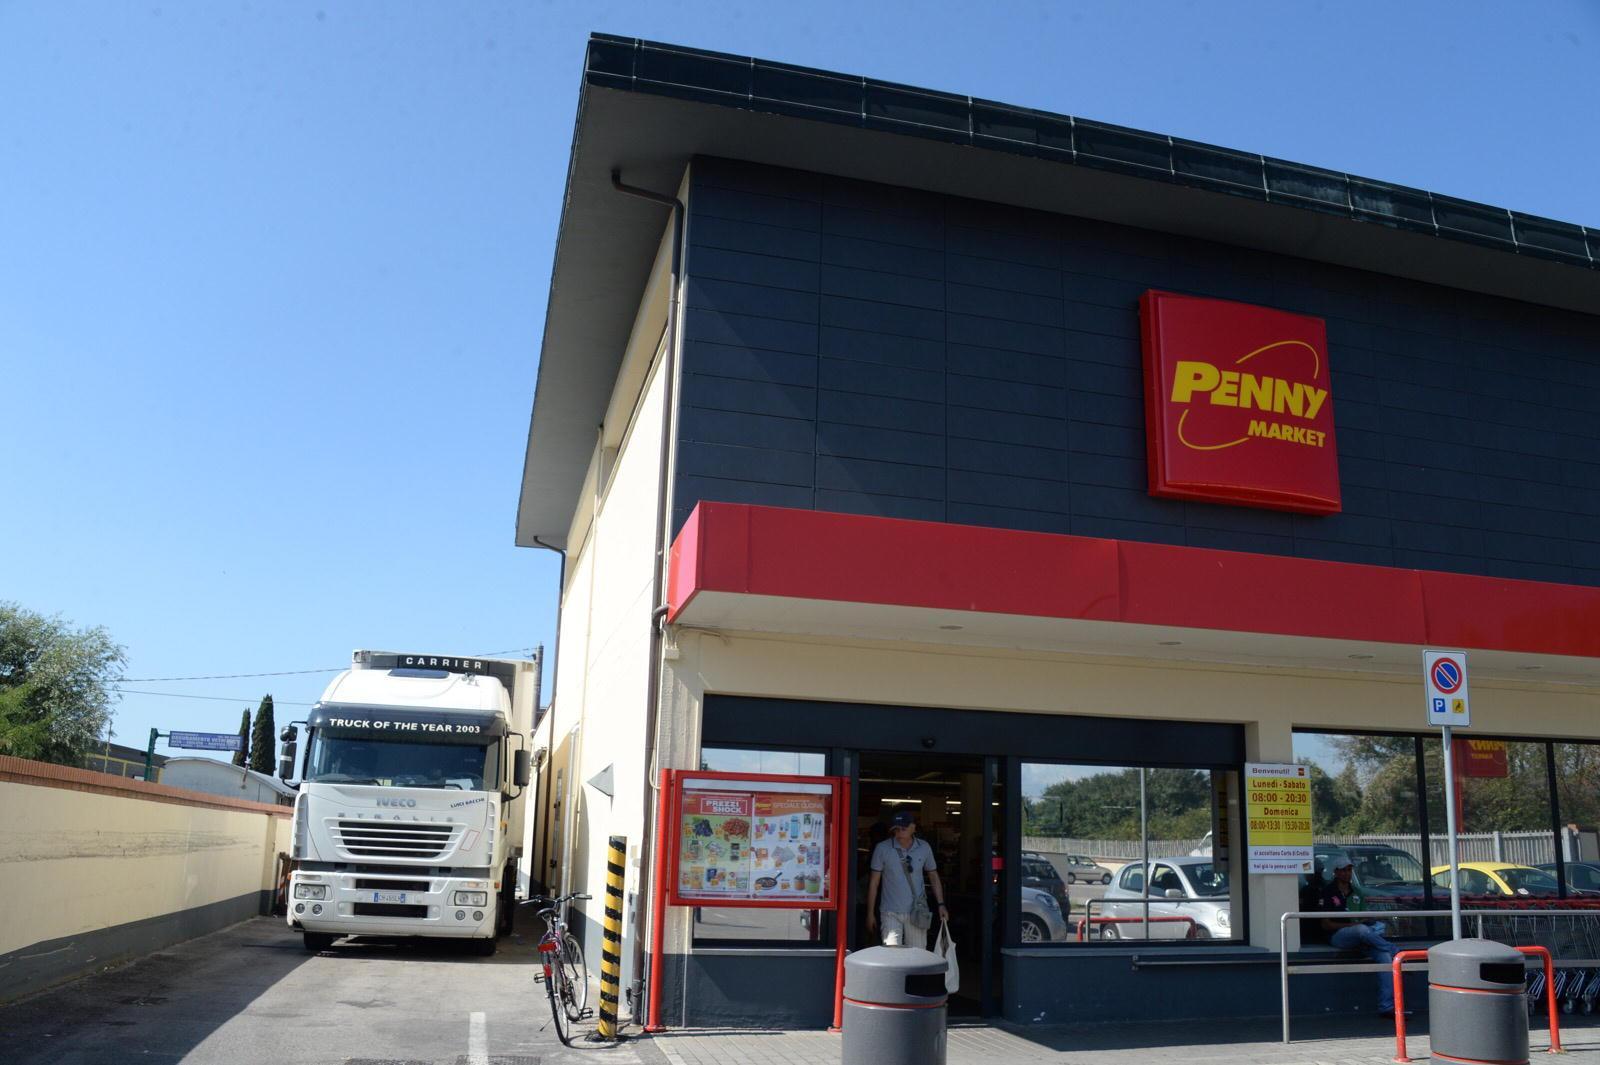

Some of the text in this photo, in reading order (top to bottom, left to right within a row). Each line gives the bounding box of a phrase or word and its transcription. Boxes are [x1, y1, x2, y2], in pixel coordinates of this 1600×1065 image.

[1170, 360, 1328, 420] PENNY
[1247, 419, 1326, 448] MARKET
[405, 657, 482, 669] CARRIER
[329, 718, 481, 734] TRUCK OF THE YEAR 2003
[1252, 767, 1290, 775] Benvenuti!
[1283, 780, 1306, 789] Sabato
[1252, 792, 1277, 802] 08:00
[1286, 793, 1307, 803] 20:30
[376, 798, 416, 808] IVECO
[712, 806, 742, 814] SHOCK
[1264, 807, 1299, 816] Domenica
